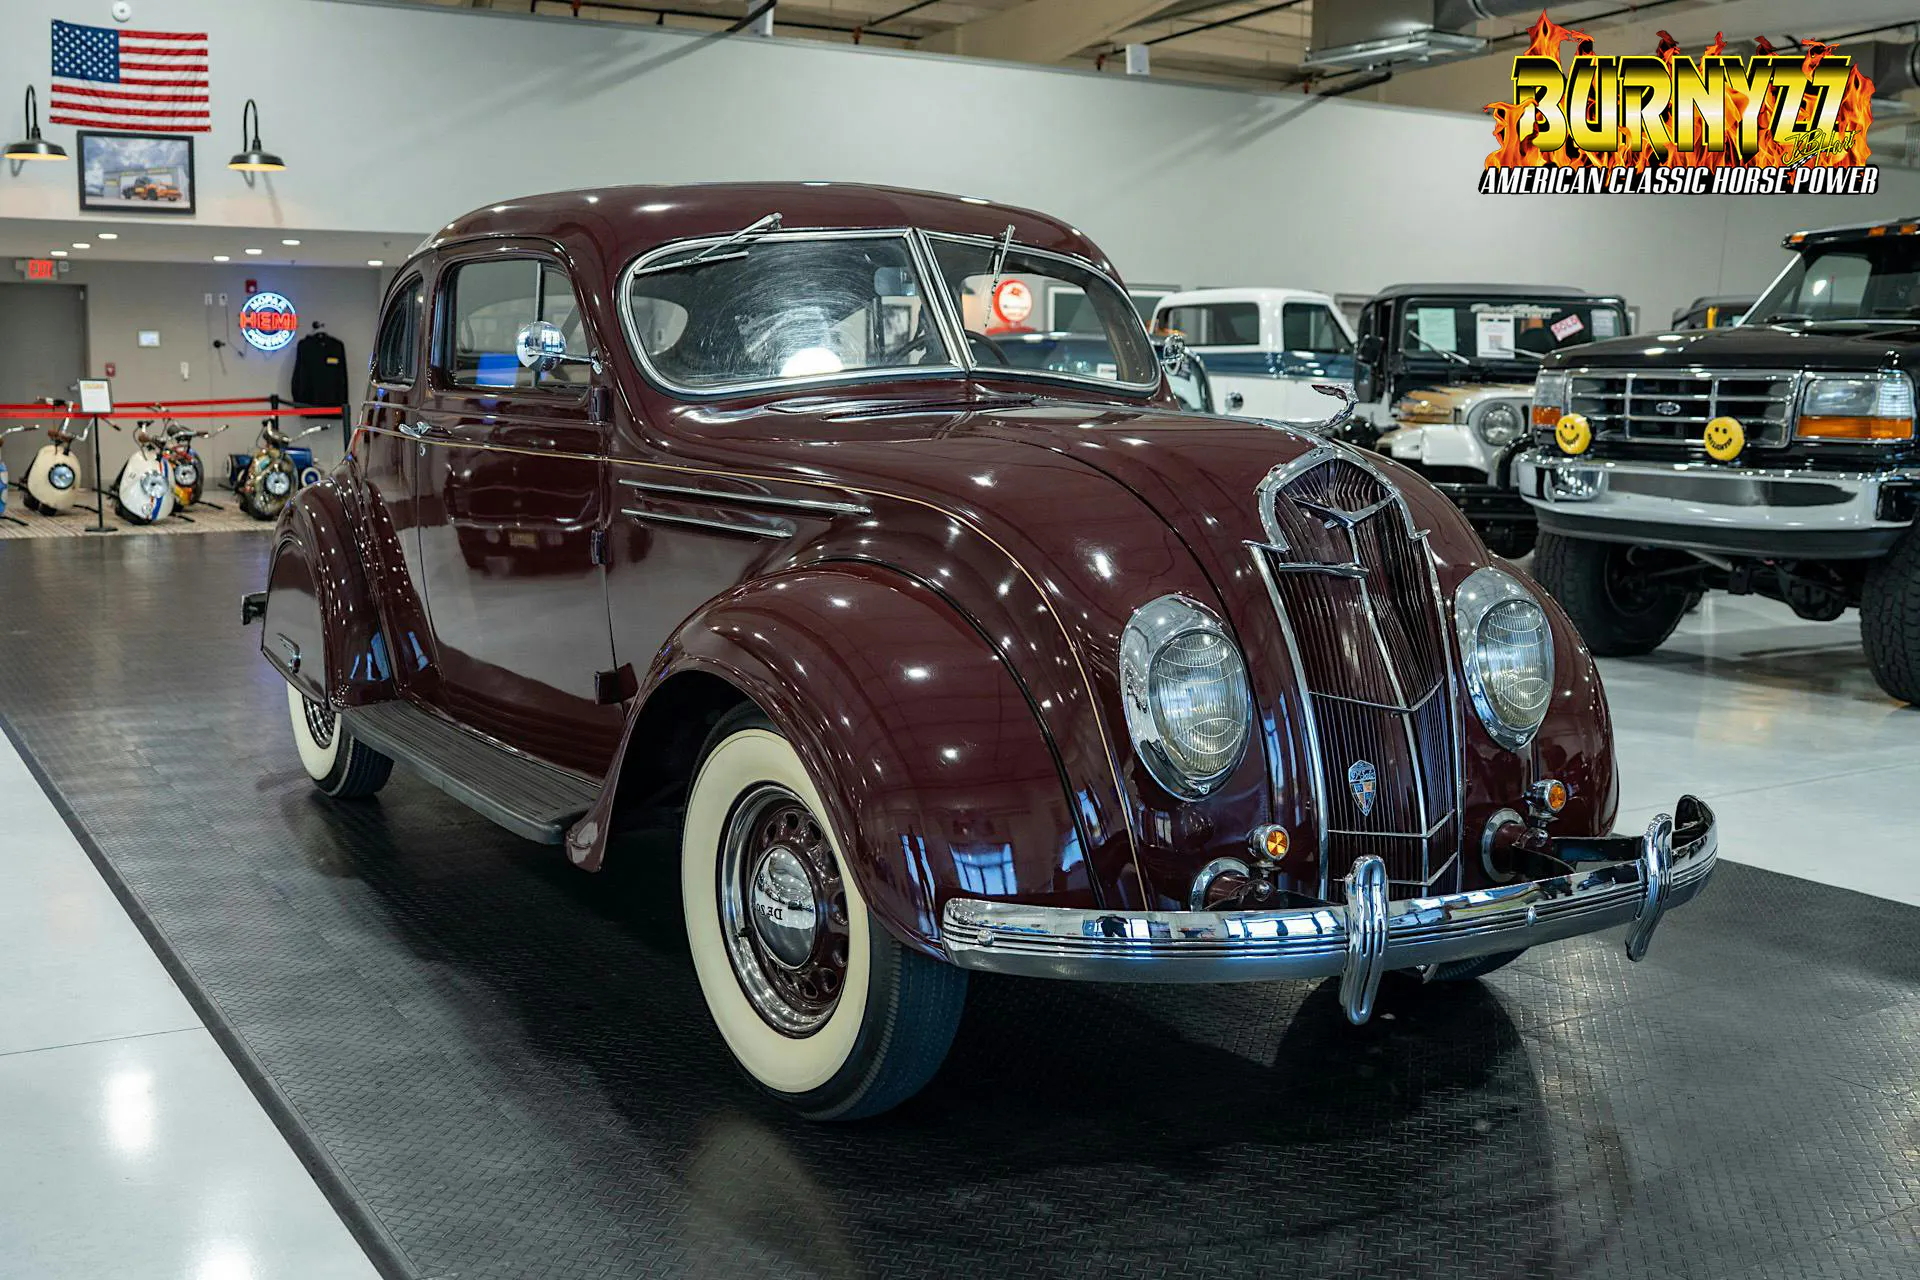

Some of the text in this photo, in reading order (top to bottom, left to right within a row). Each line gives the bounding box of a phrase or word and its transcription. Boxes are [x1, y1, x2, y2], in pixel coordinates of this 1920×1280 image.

[28, 259, 54, 279] EXIT
[249, 295, 287, 310] MOPAR
[240, 312, 297, 330] HEMI
[247, 330, 290, 347] POWERED
